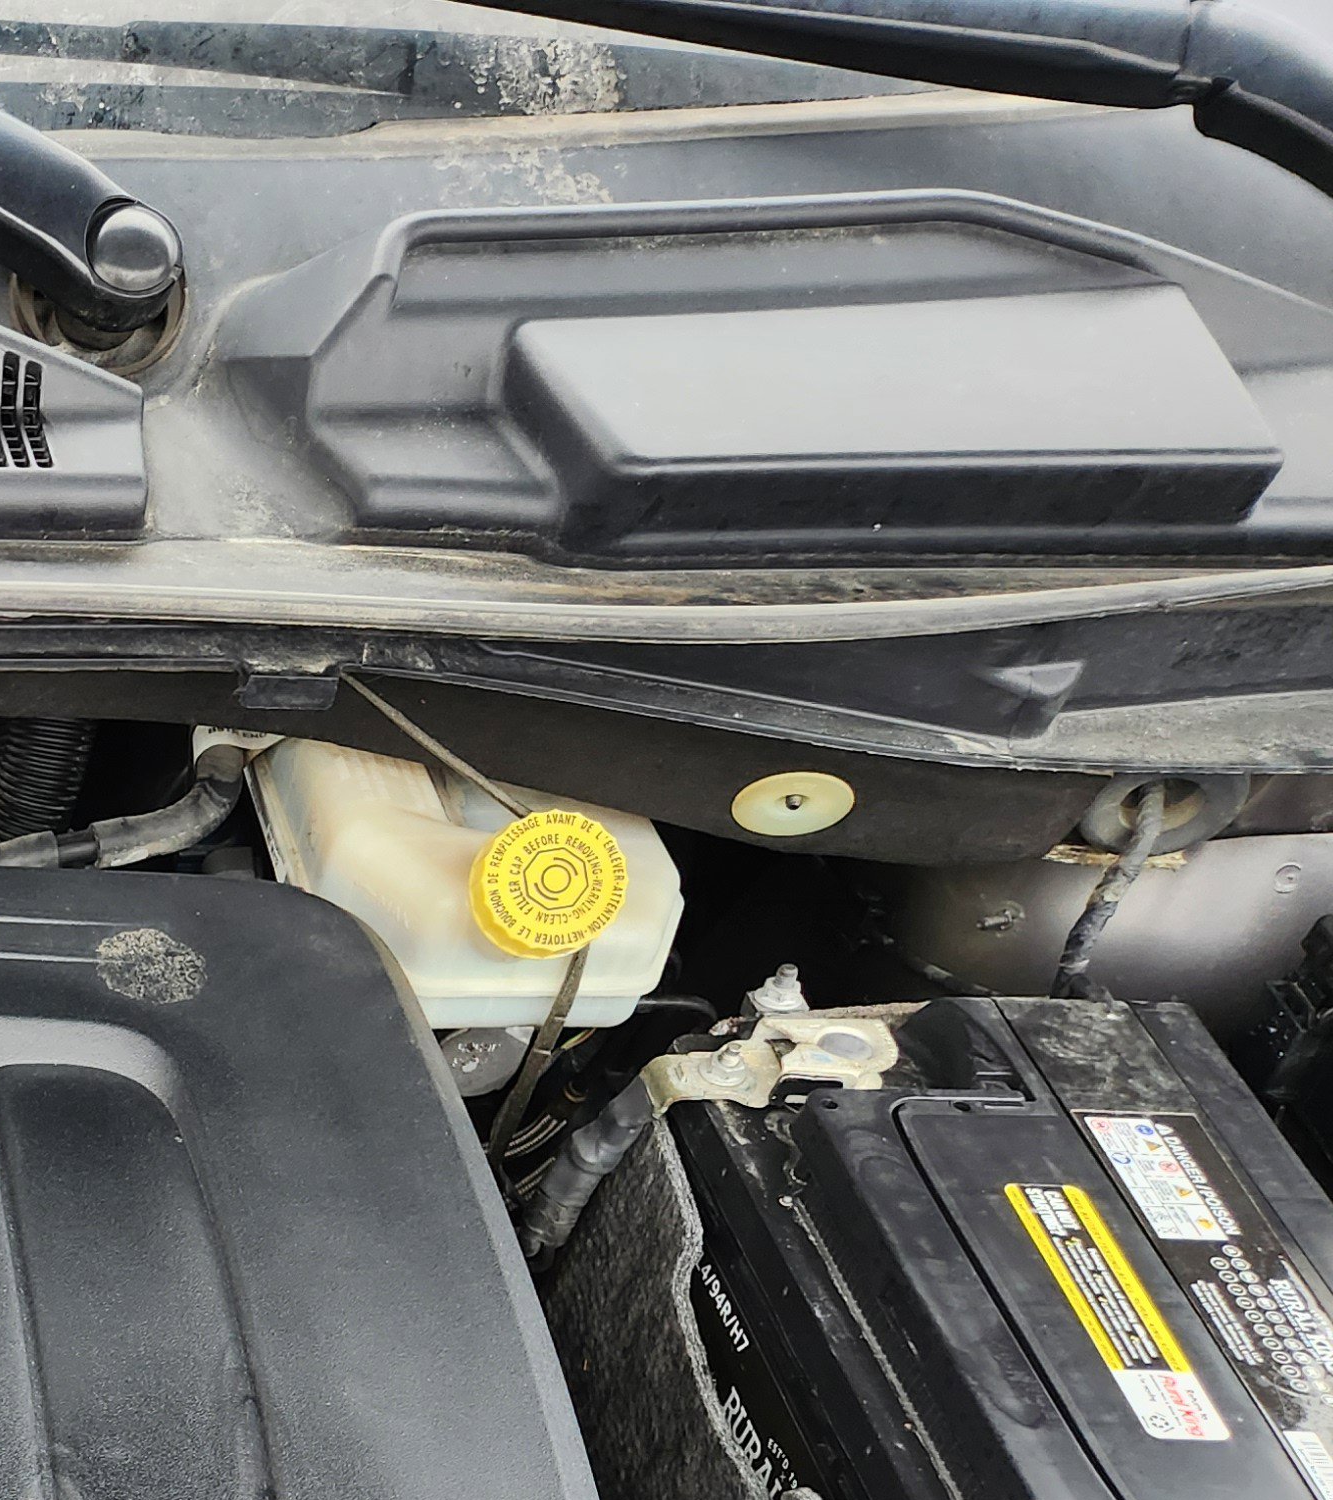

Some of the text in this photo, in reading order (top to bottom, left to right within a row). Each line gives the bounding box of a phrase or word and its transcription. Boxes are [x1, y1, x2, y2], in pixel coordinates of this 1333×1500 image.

[487, 872, 499, 883] DE
[546, 814, 576, 826] AVANT
[581, 820, 593, 833] DE
[524, 834, 560, 855] BEFORE
[510, 855, 523, 875] CAP
[508, 879, 534, 915] FILLER
